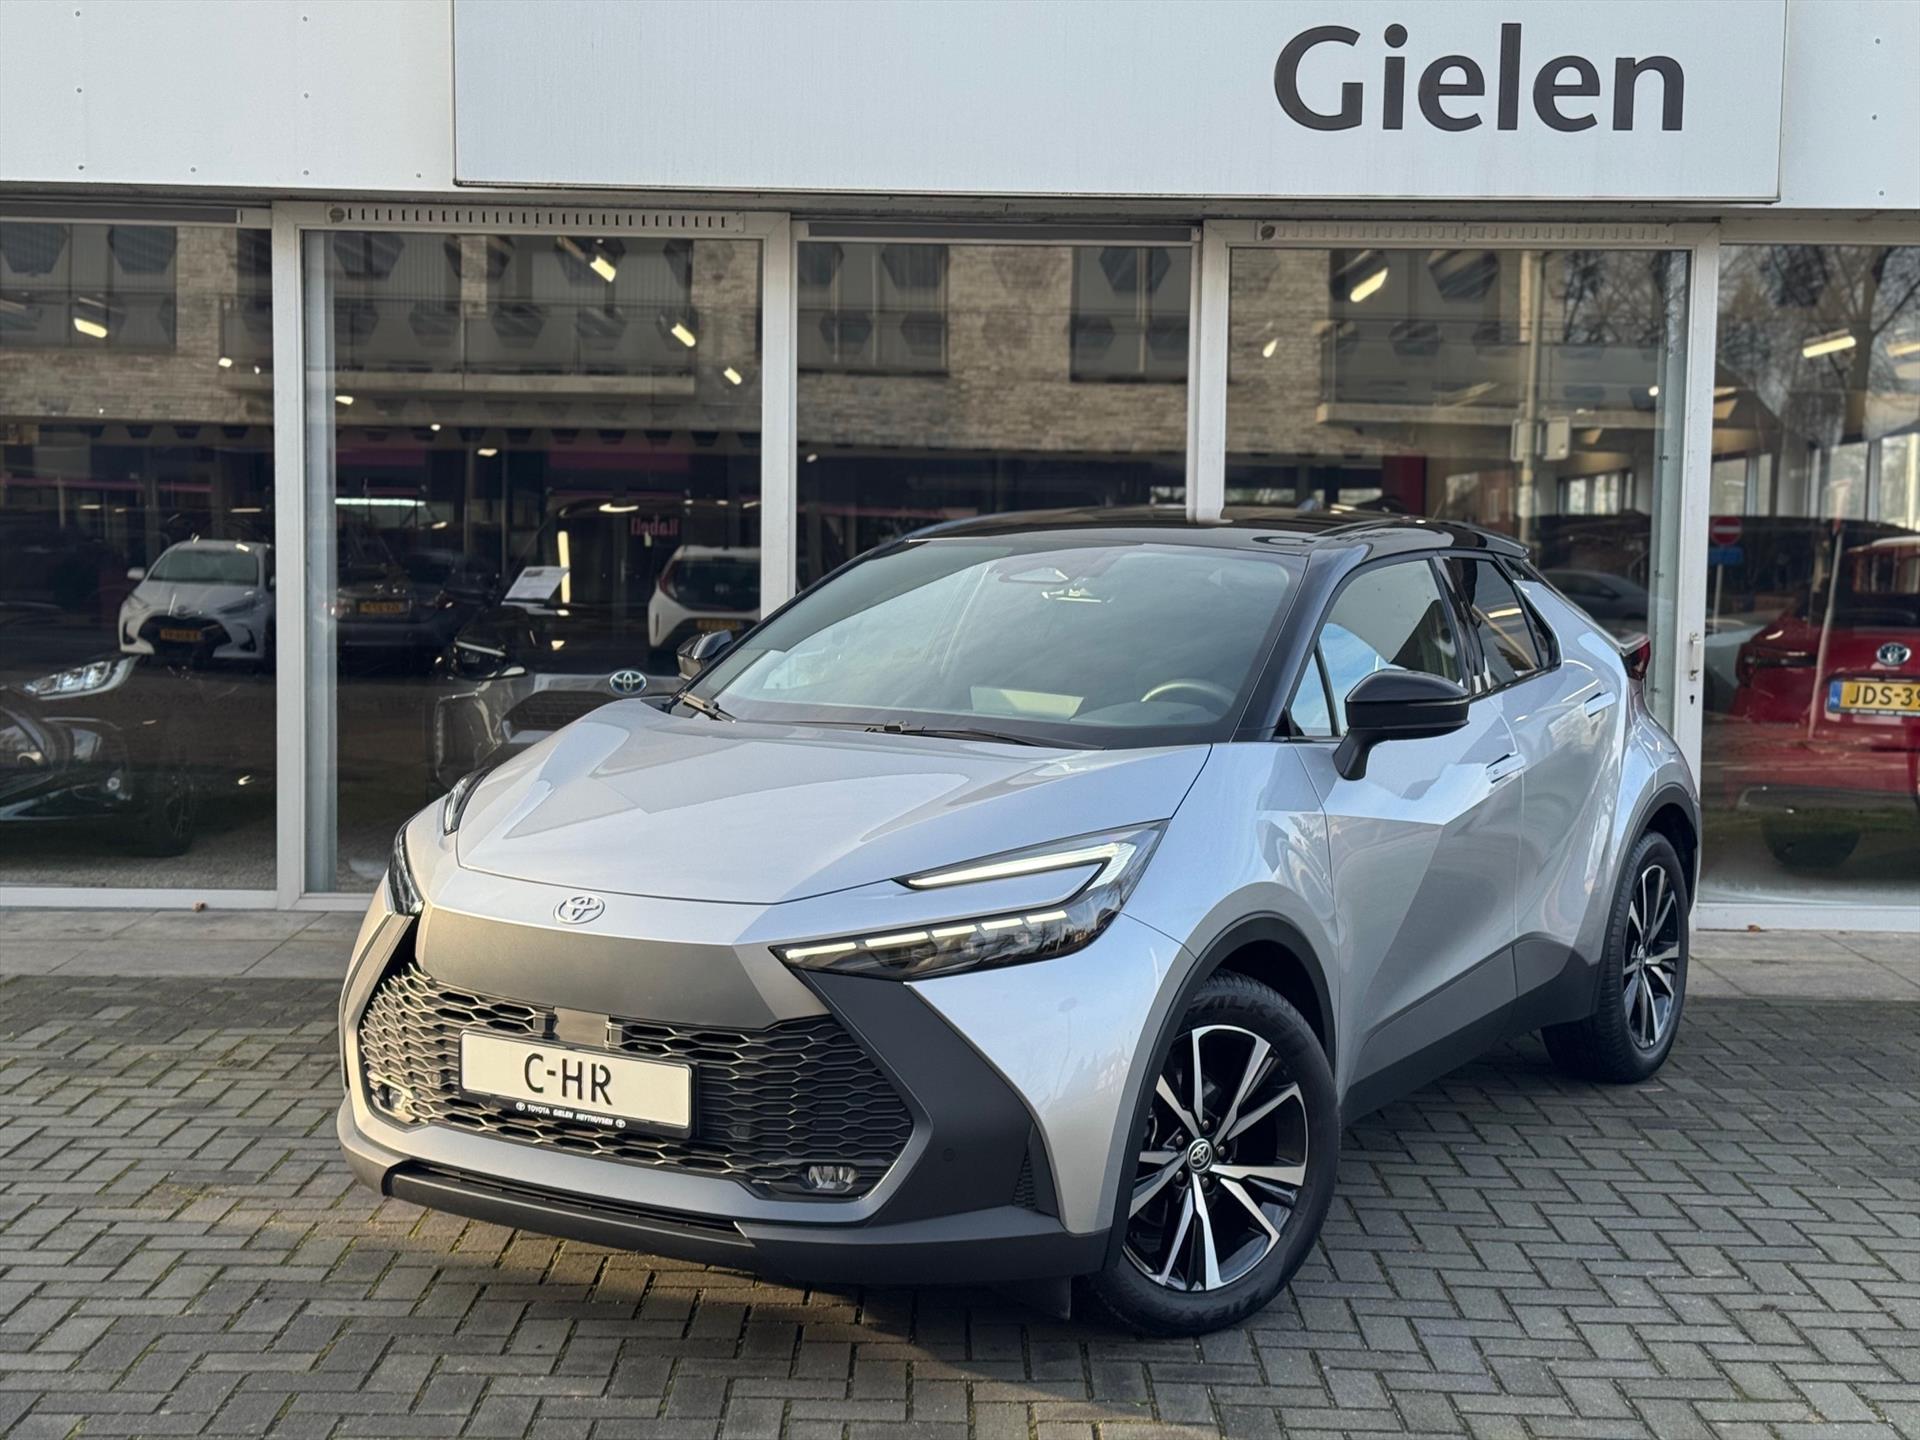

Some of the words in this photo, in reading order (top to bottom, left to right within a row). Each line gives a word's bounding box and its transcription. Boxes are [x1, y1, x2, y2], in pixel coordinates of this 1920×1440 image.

[1274, 23, 1685, 132] Gielen
[524, 1053, 613, 1106] C-HR
[527, 1104, 550, 1115] TOYOTA
